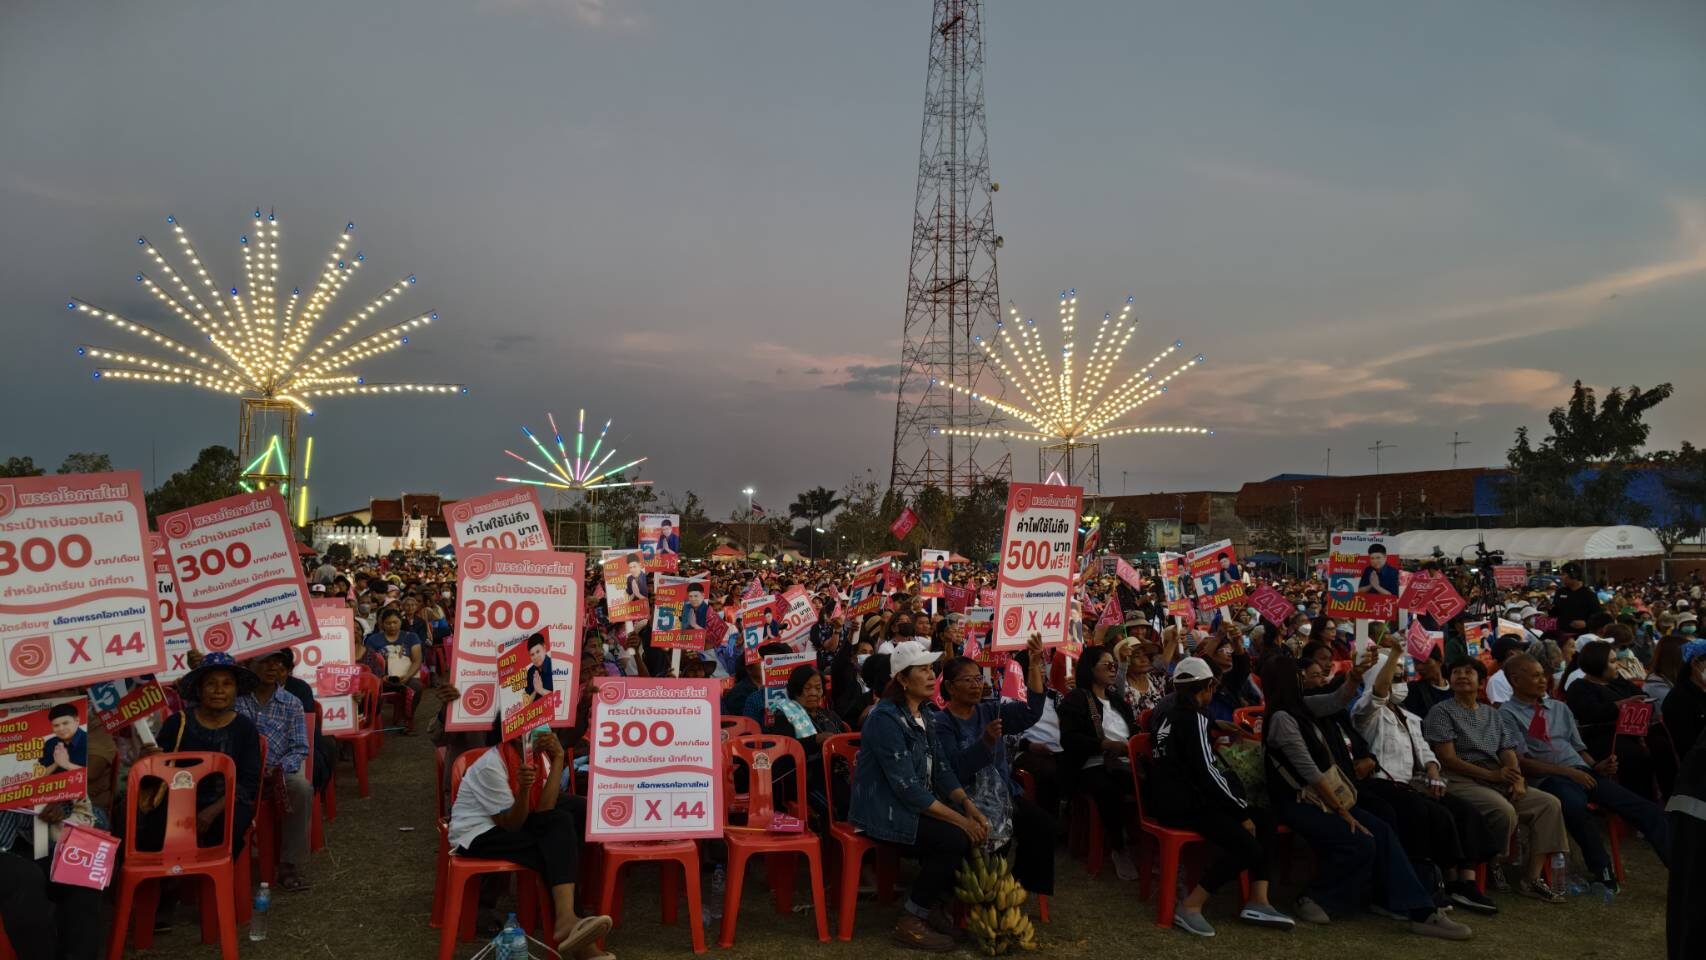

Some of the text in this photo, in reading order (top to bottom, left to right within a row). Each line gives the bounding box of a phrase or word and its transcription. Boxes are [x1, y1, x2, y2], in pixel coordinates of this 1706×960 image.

[20, 483, 129, 505] พรรคโอกาสใหม่
[193, 497, 272, 526] พรรคโอกาสใหม่
[180, 518, 271, 550] กระเป๋าเงินออนไลน์
[466, 511, 530, 536] ค่าไฟใช้ไม่ถึง
[518, 524, 539, 536] บาท
[1017, 517, 1070, 534] ค่าไฟใช้ไม่ถึง
[519, 533, 543, 549] ฟรี!!
[0, 534, 140, 577] 300 บาท/เดือน
[176, 542, 287, 583] 300 บาท/เดือน
[1006, 540, 1070, 570] 500 บาท
[1050, 554, 1070, 570] ฟรี!!
[496, 560, 574, 576] พรรคโอกาสใหม่
[921, 571, 930, 587] 5
[4, 574, 135, 597] สำหรับนักเรียน นักศึกษา
[192, 577, 249, 598] สำหรับนักเรียน
[252, 568, 286, 581] นักศึกษา
[474, 583, 567, 596] กระเป๋าเงินออนไลน์
[1200, 574, 1218, 596] 5
[1330, 573, 1355, 602] 5
[229, 590, 297, 614] เลือกพรรคโอกาสใหม่
[851, 587, 864, 607] 5
[1215, 584, 1243, 606] แรมโบ้
[53, 606, 146, 626] เลือกพรรคโอกาสใหม่
[464, 599, 540, 630] 300
[657, 606, 675, 631] 5
[1255, 593, 1290, 624] 44
[242, 618, 262, 641] X
[271, 610, 300, 631] 44
[1027, 610, 1061, 631] X 44
[66, 631, 145, 664] X 44
[746, 625, 759, 649] 5
[172, 653, 186, 670] X
[335, 674, 350, 691] 5
[628, 685, 708, 698] พรรคโอกาสใหม่
[93, 682, 162, 719] 5 แรมโบ้
[608, 706, 702, 716] กระเป๋าเงินออนไลน์
[323, 707, 346, 721] 44
[599, 720, 675, 747] 300
[605, 754, 703, 764] สำหรับนักเรียน นักศึกษา
[38, 778, 67, 794] อีสาน
[637, 781, 709, 789] เลือกพรรคโอกาสใหม่
[644, 799, 706, 821] X 44
[63, 846, 94, 867] 5
